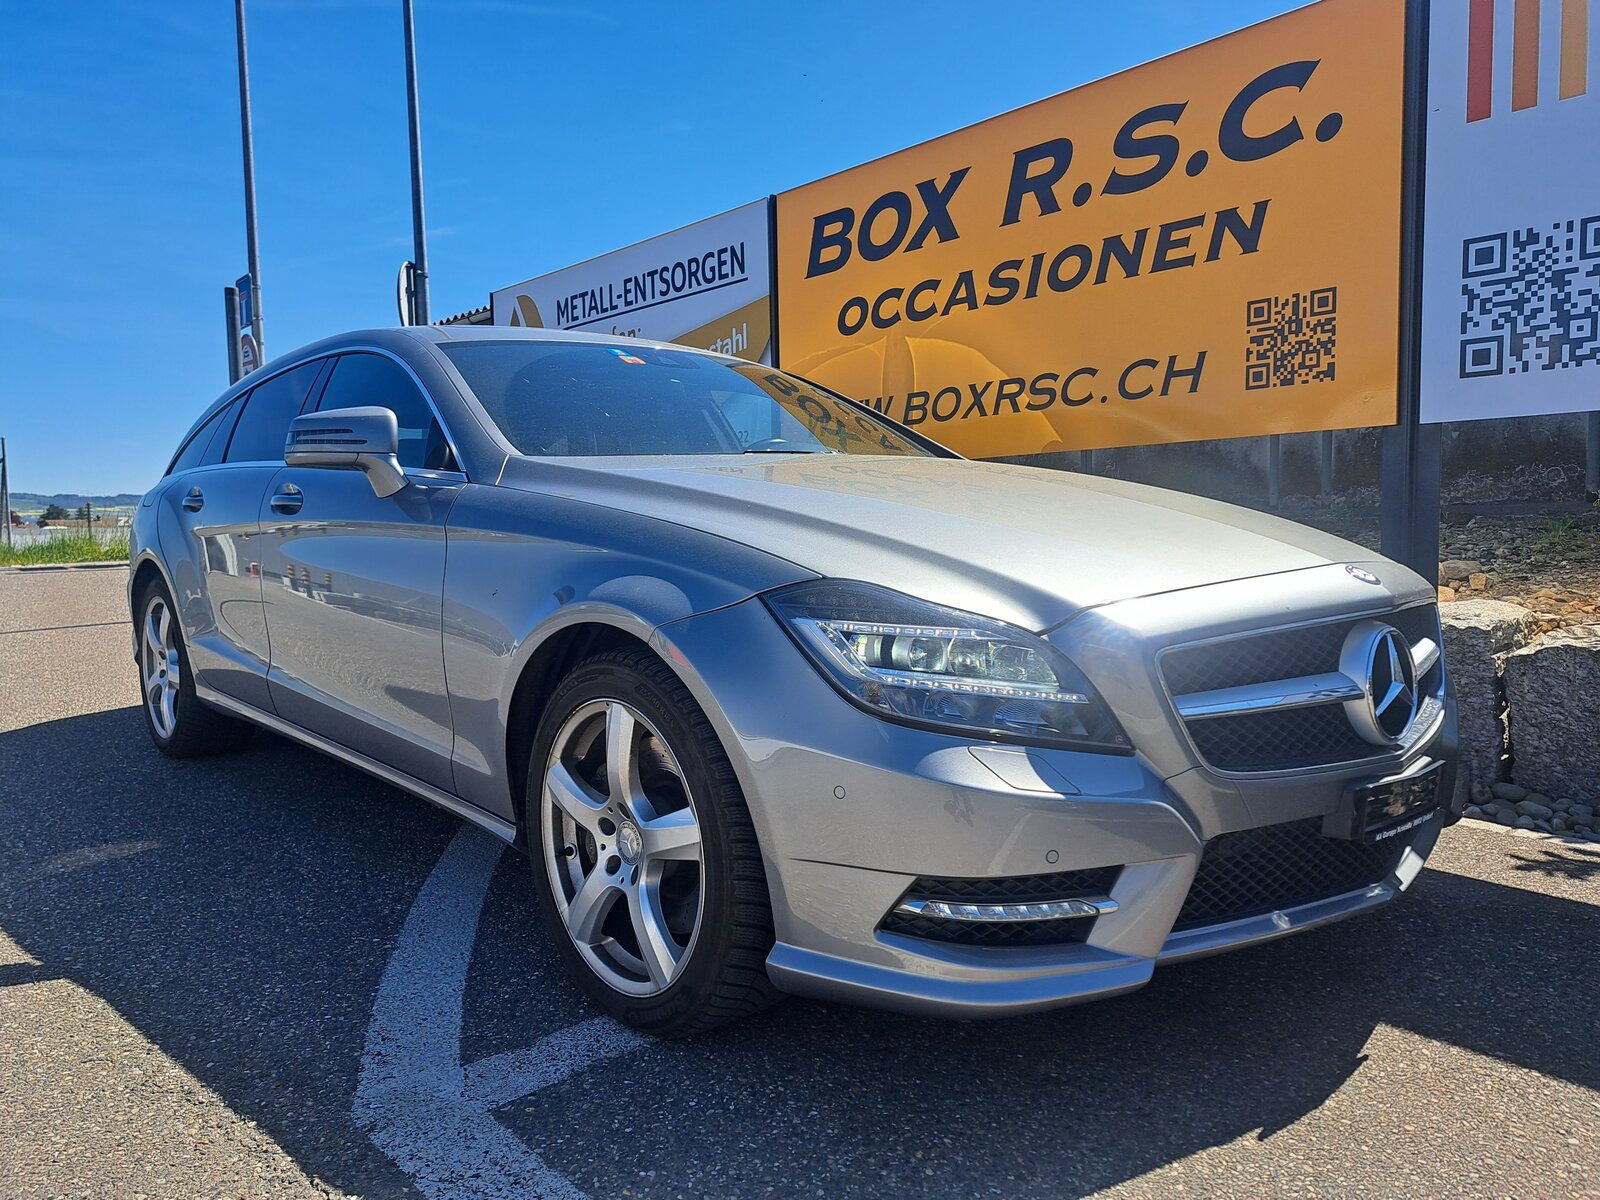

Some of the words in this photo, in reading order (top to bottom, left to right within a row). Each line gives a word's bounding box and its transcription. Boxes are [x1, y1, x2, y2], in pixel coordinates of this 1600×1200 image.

[804, 167, 971, 279] BOX
[999, 58, 1343, 227] R.S.C.
[556, 242, 745, 326] METALL-ENTSORGEN
[837, 199, 1272, 336] OCCASIONEN
